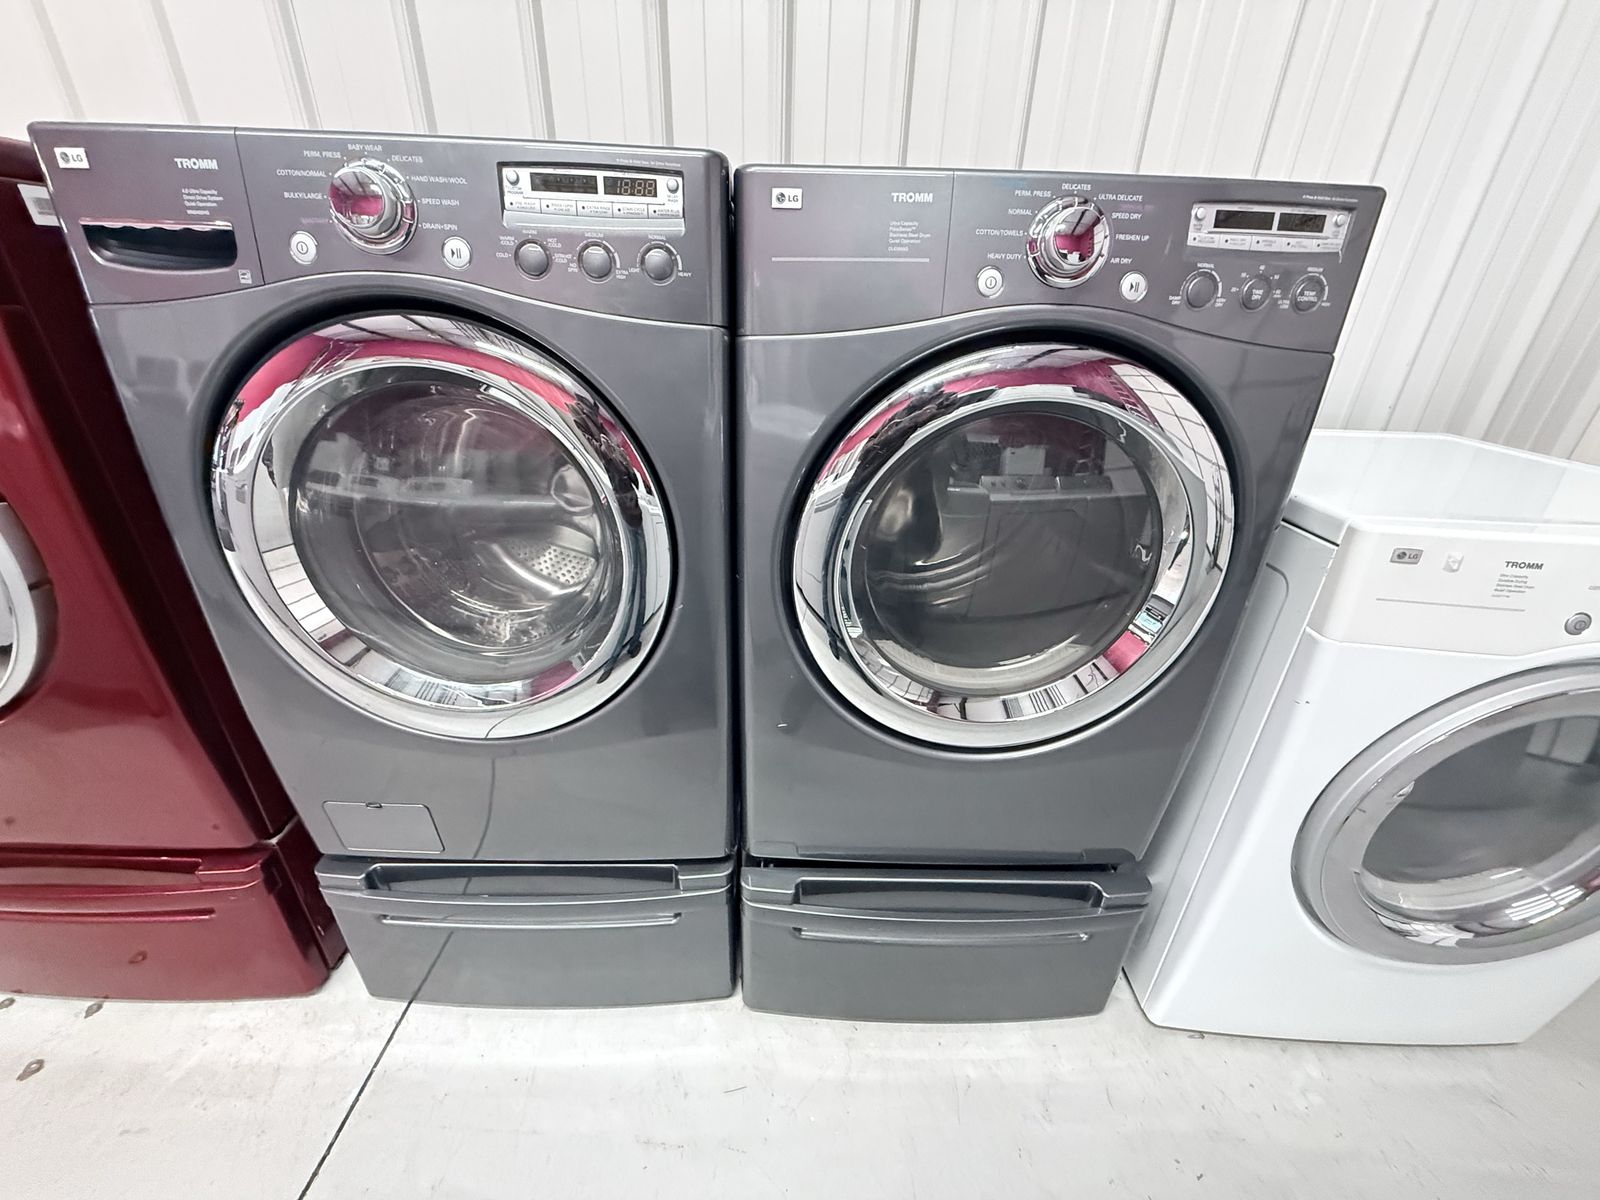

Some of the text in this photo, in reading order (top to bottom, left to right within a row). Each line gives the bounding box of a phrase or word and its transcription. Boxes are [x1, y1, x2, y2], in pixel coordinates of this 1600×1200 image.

[71, 153, 84, 162] LG
[391, 155, 424, 163] DELICATES
[174, 157, 219, 170] TROMM
[411, 175, 428, 183] HAND
[1061, 183, 1092, 191] DELICATES
[787, 194, 799, 203] LG
[890, 192, 934, 203] TROMM
[1117, 194, 1143, 202] DELICATE
[421, 198, 441, 206] SPEED
[1007, 208, 1033, 216] NORMAL
[1111, 211, 1130, 219] SPEED
[1115, 233, 1150, 242] FRESHEN UP
[987, 252, 1006, 260] HEAVY
[1407, 552, 1419, 560] LG
[1504, 560, 1545, 570] TROMM
